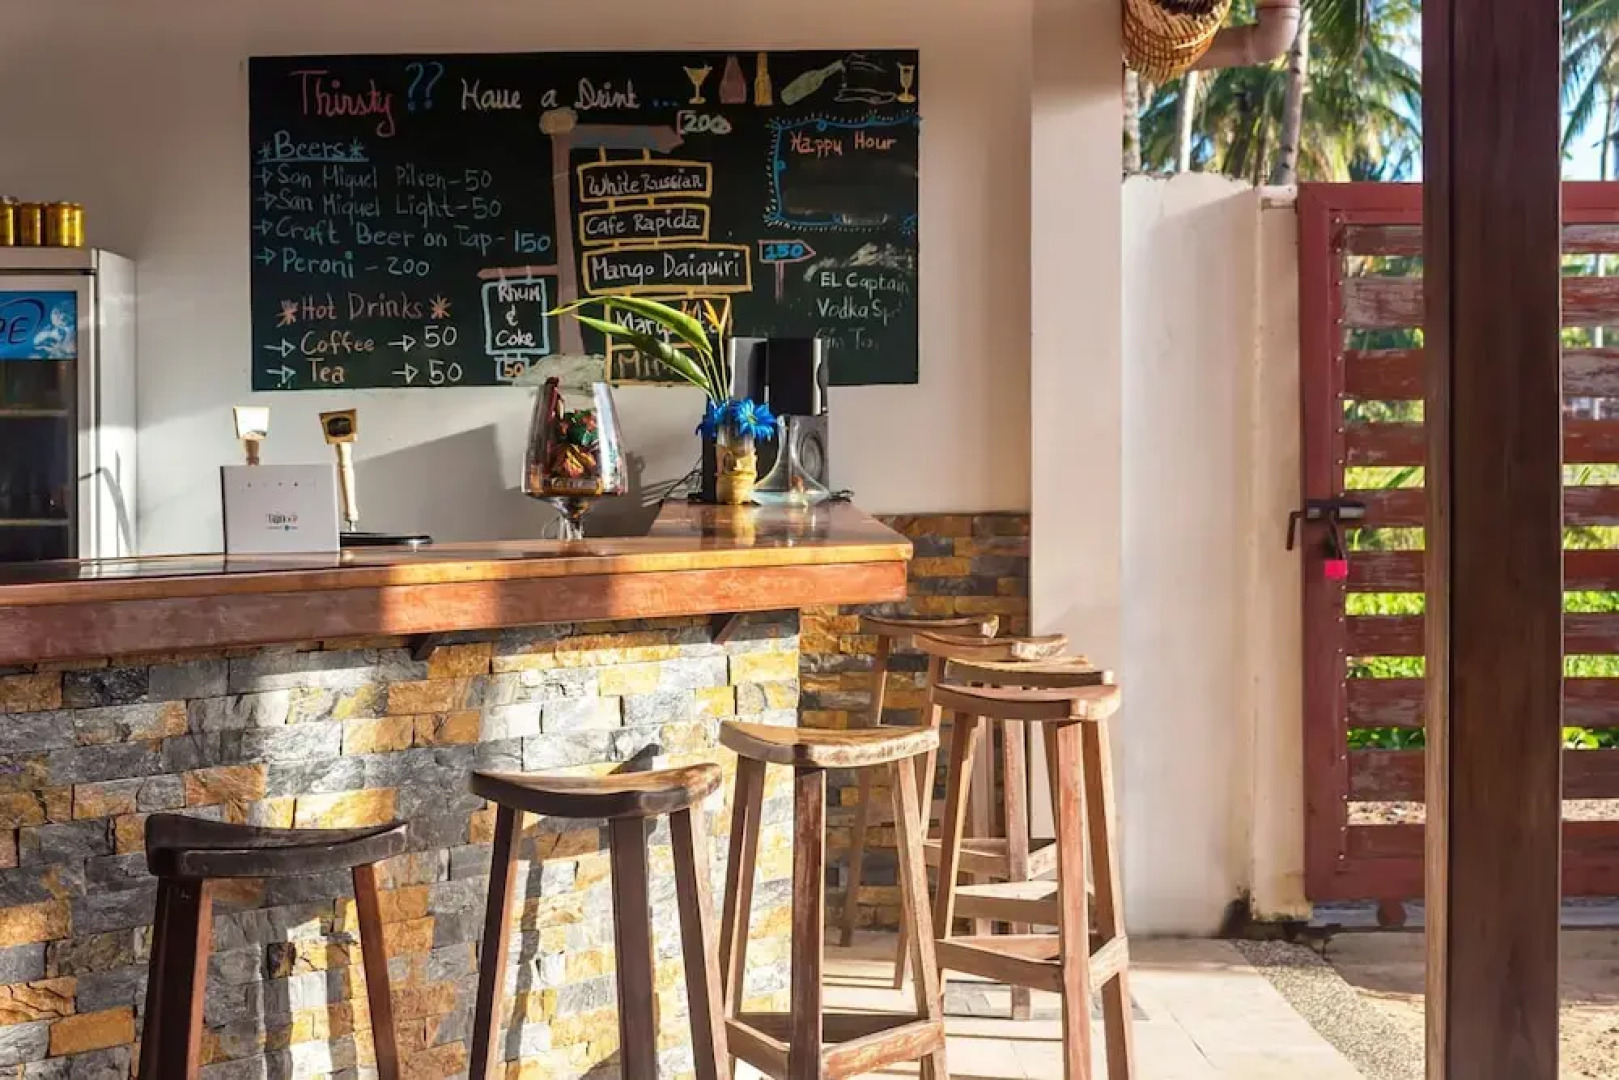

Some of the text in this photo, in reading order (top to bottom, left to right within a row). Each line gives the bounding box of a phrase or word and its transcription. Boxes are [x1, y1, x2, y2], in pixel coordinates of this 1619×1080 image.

[288, 69, 395, 136] Thirsty
[461, 78, 521, 111] Have
[540, 88, 557, 108] a
[274, 130, 344, 159] Beers
[790, 130, 897, 159] Happy Hour
[276, 163, 312, 188] San
[322, 164, 378, 198] Miguel
[465, 169, 493, 192] 50
[585, 168, 704, 197] White Russian
[276, 187, 314, 212] San
[322, 193, 380, 226] Miguel
[395, 190, 455, 228] Light
[472, 196, 502, 220] 50
[276, 215, 342, 246] Craft
[356, 222, 415, 247] Beer
[423, 231, 448, 247] on
[453, 224, 493, 257] Tap
[513, 229, 551, 254] 150
[585, 207, 702, 239] Cafe Rapida
[282, 248, 355, 279] Peroni
[386, 257, 430, 276] 200
[764, 244, 805, 260] 150
[590, 252, 740, 286] Mango Daiquiri
[301, 292, 423, 320] Hot Drinks
[816, 296, 869, 319] Vodka
[300, 325, 457, 355] Coffee 50
[495, 329, 536, 348] Coke
[306, 358, 462, 384] Tea 50
[503, 361, 525, 377] 50
